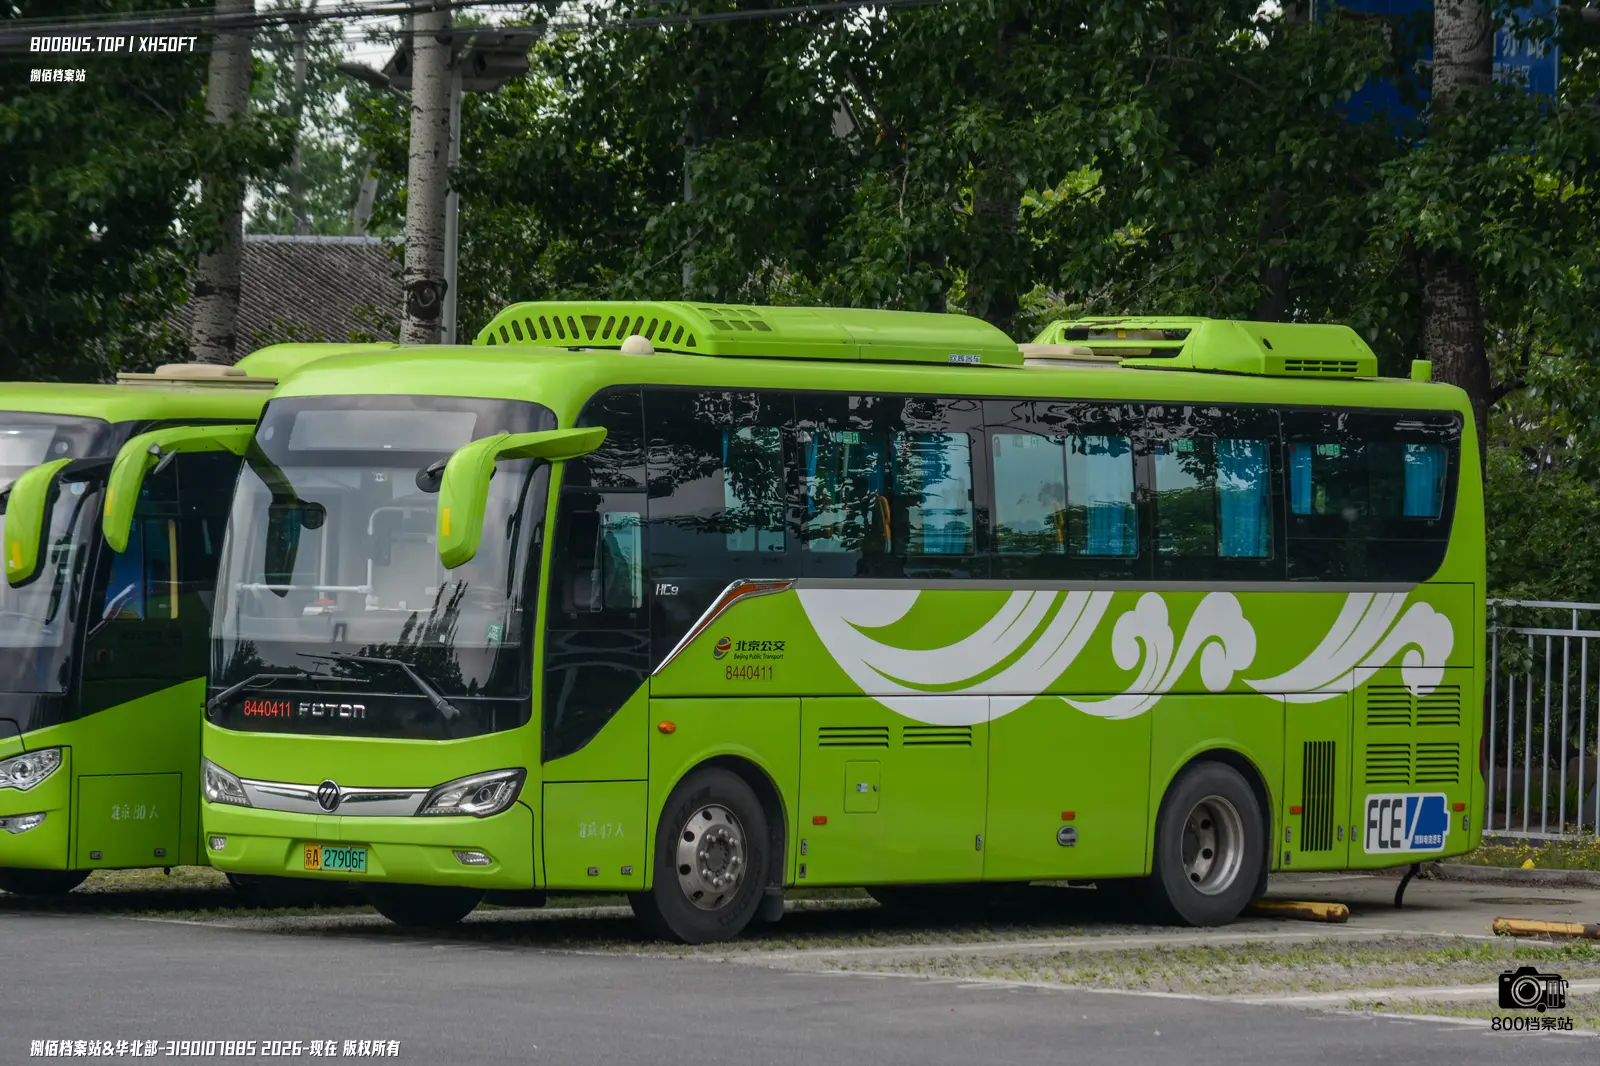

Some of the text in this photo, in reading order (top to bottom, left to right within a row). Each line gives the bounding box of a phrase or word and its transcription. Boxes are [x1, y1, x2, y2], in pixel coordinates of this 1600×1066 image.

[655, 583, 679, 596] HC9
[735, 640, 786, 652] 北京公交
[725, 665, 773, 680] 8440411
[243, 700, 365, 719] 8440411 FOTON
[305, 848, 365, 868] 京A 27906F
